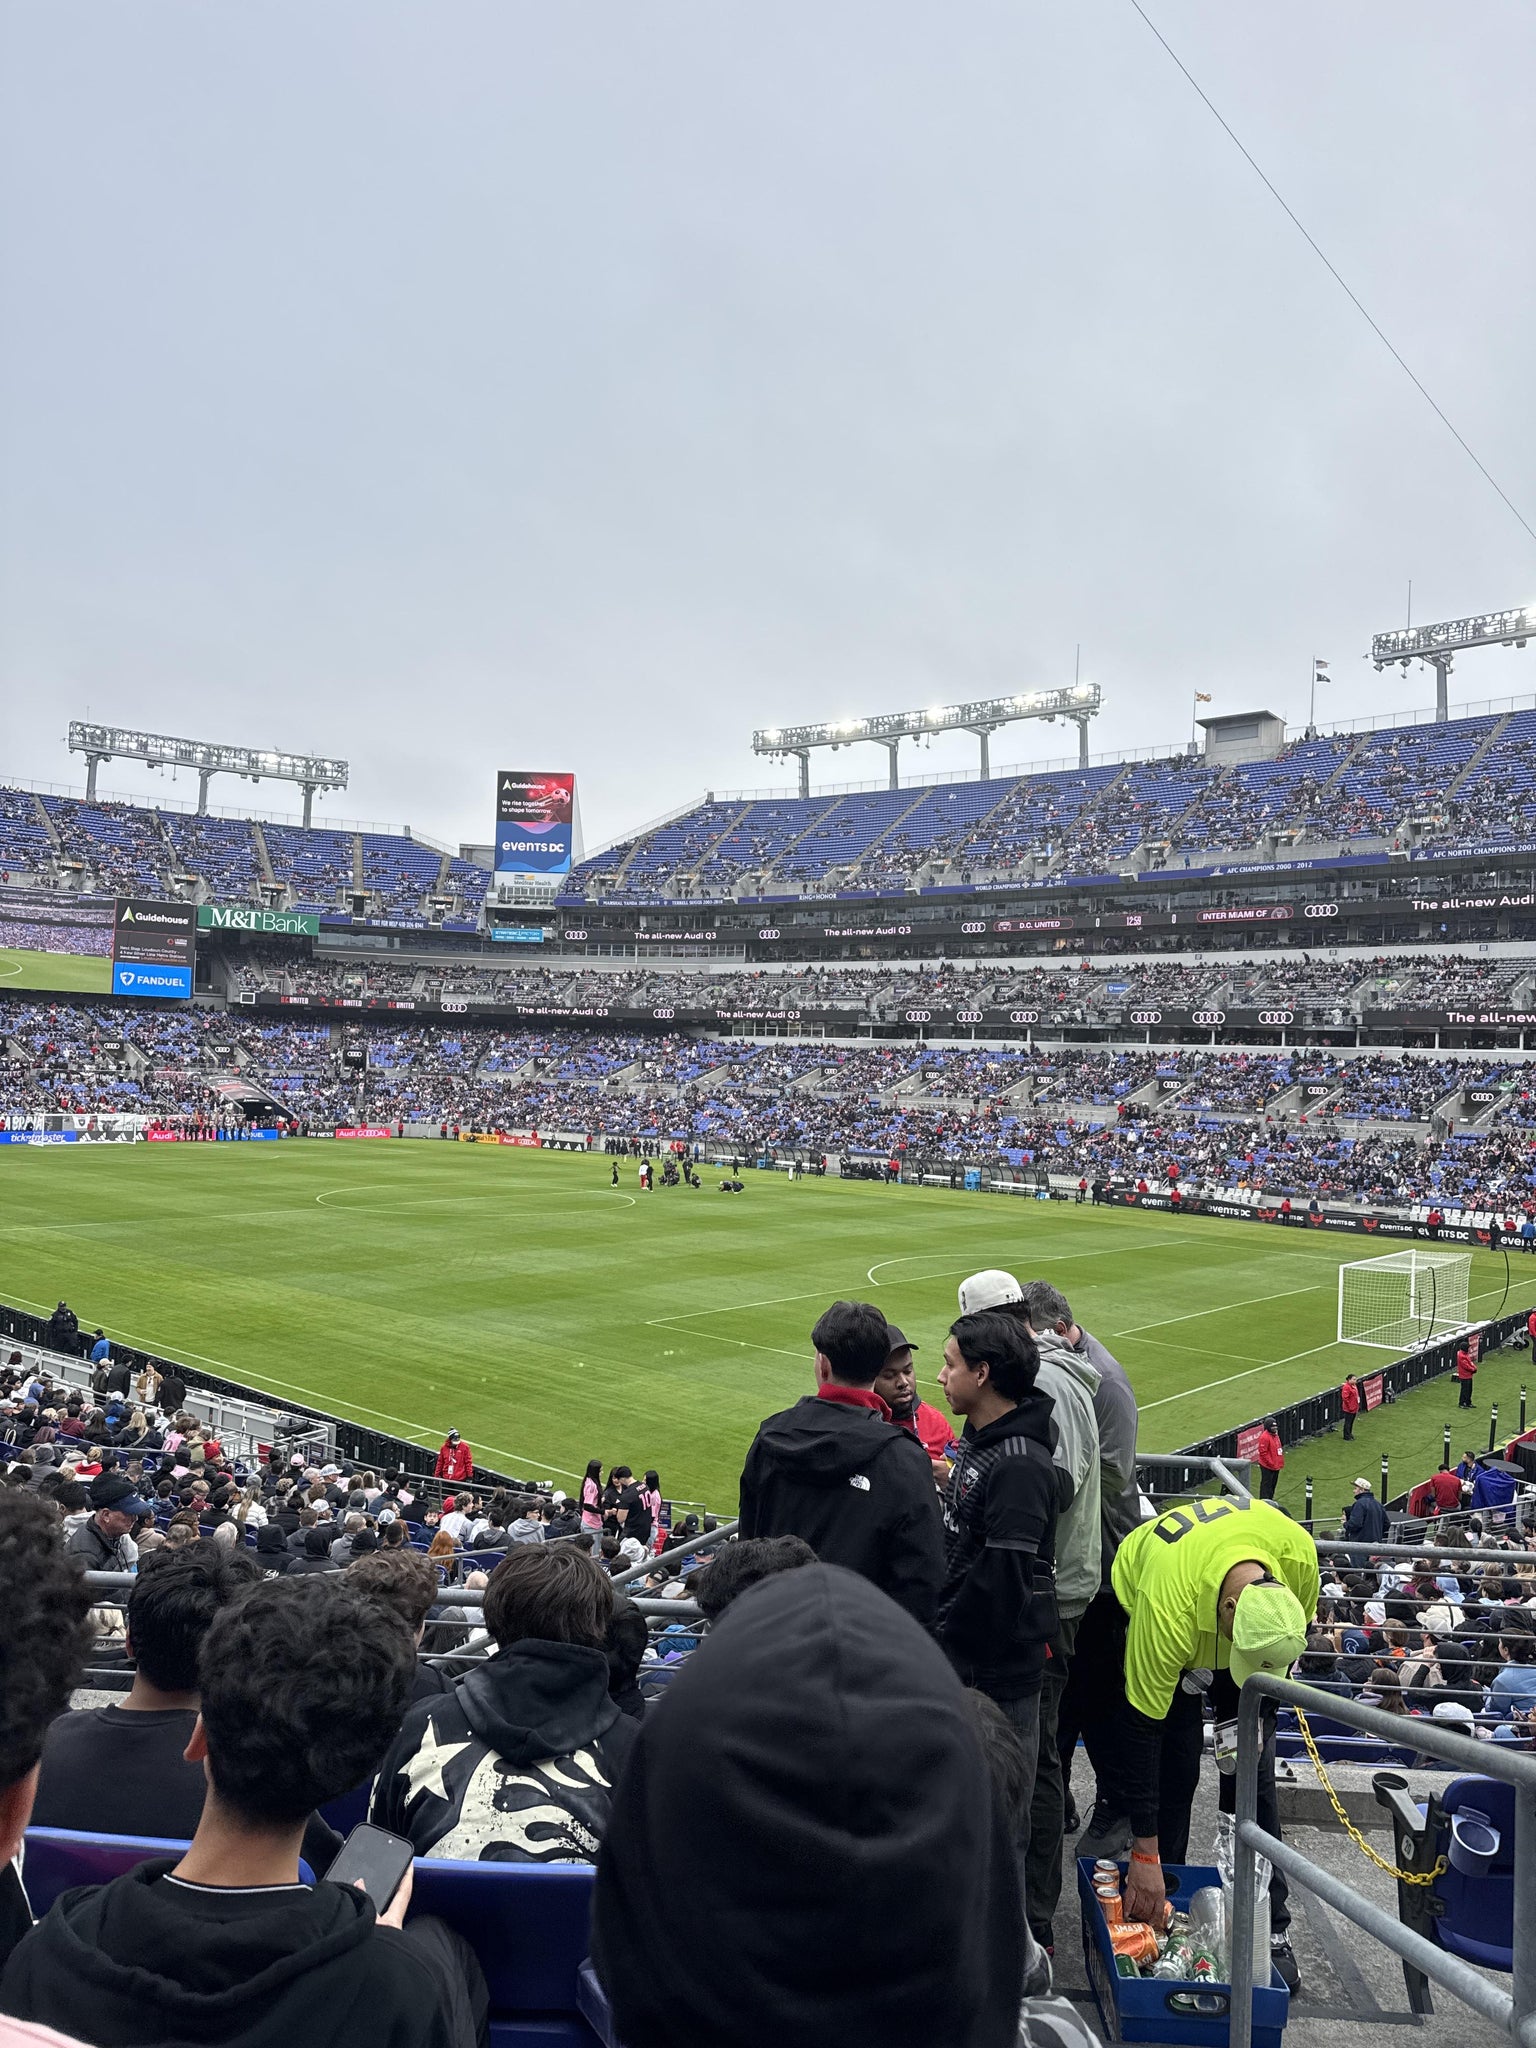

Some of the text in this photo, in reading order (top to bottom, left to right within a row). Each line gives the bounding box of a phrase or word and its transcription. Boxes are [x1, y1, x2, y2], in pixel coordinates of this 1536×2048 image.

[1447, 849, 1472, 857] NORTH
[1473, 845, 1516, 855] CHAMPIONS
[1239, 864, 1275, 873] CHAMPIONS
[1412, 894, 1535, 910] The all-new Audi
[135, 912, 189, 925] Guidehouse
[1203, 909, 1268, 920] INTER MIAMI CF
[210, 907, 308, 934] M&T Bank
[634, 932, 717, 940] The all-new Audi Q3
[841, 928, 874, 936] all-new
[875, 927, 896, 935] Audi
[898, 926, 911, 935] Q3
[137, 975, 185, 987] FANDUEL
[289, 997, 309, 1005] UNITED
[343, 999, 362, 1007] UNITED
[396, 1001, 415, 1009] UNITED
[516, 1006, 609, 1017] The all-new Audi Q3
[715, 1010, 731, 1018] The
[733, 1010, 763, 1018] all-new
[787, 1011, 801, 1019] Q3
[1446, 1012, 1536, 1023] The all-new
[1456, 1231, 1469, 1240] DC
[638, 1490, 652, 1511] 10
[1113, 1923, 1144, 1934] SMASH
